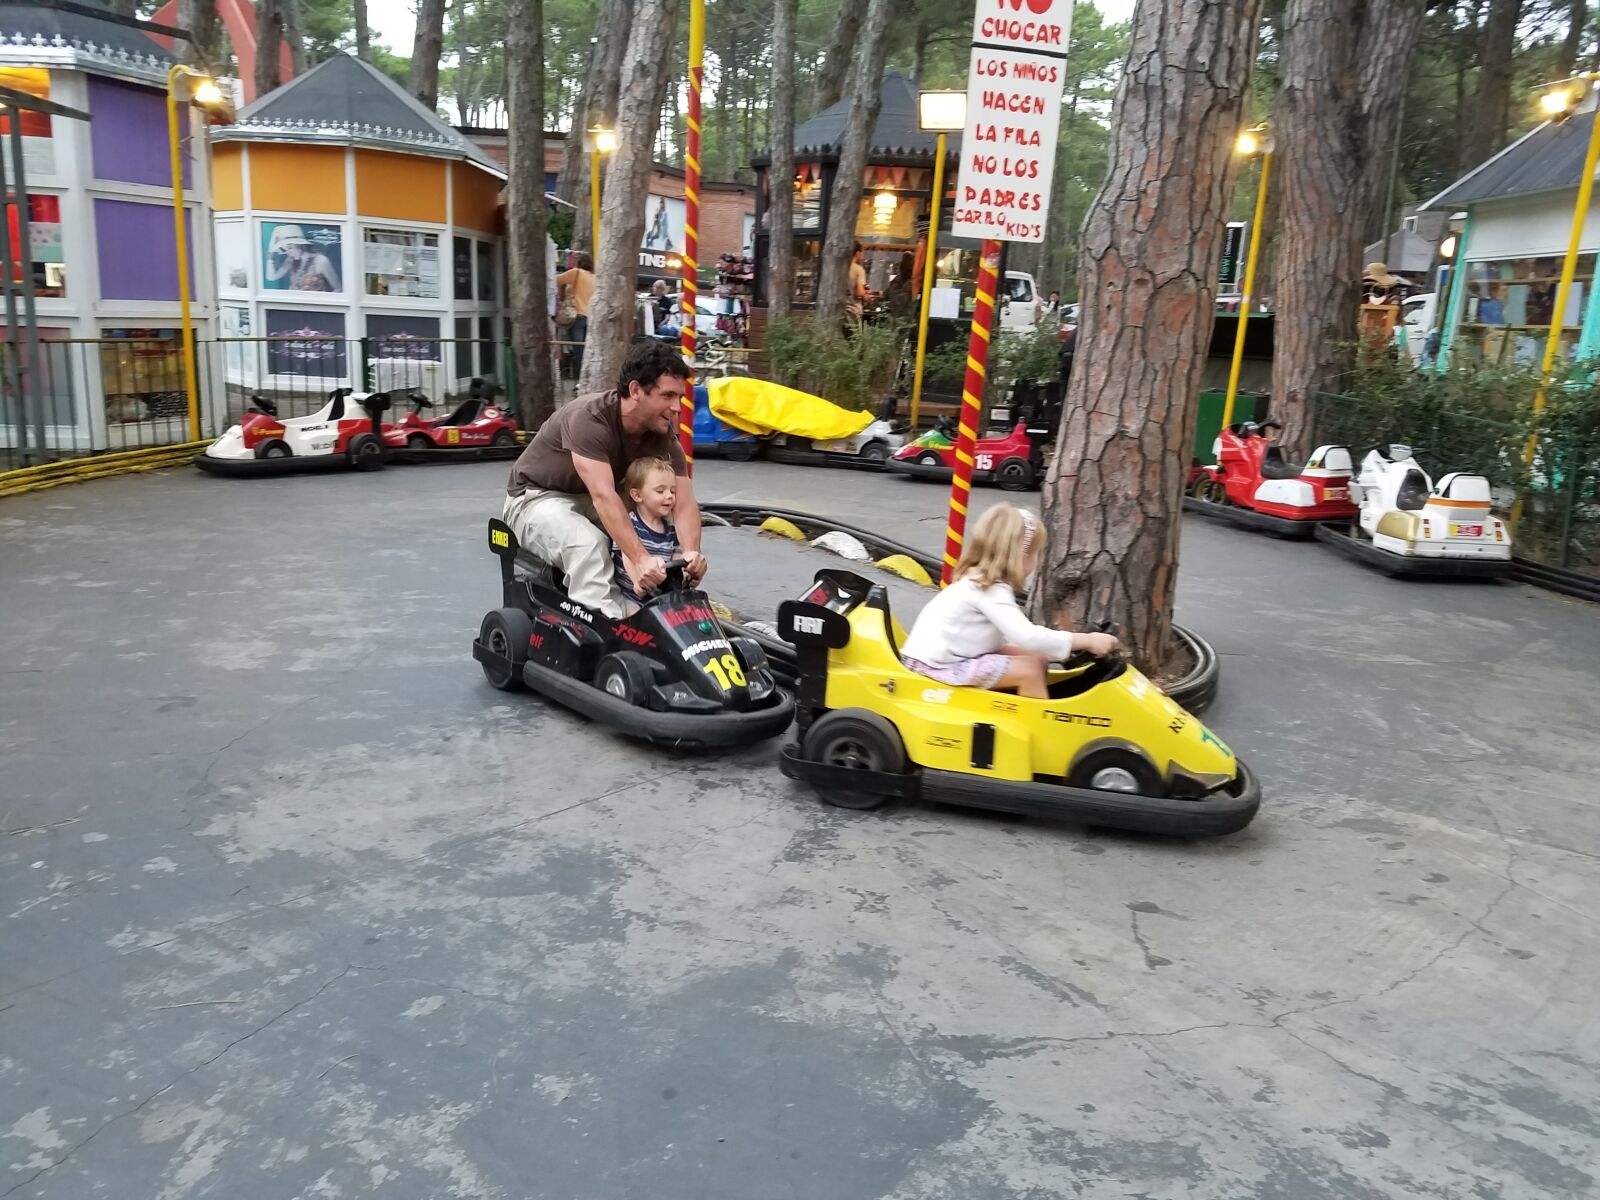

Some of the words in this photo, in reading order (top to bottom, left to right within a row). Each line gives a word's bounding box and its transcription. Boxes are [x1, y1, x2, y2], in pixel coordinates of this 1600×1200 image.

[982, 17, 1061, 45] CHOCAR
[977, 58, 1007, 77] LOS
[983, 90, 1045, 114] HACEN
[976, 123, 996, 142] LA
[1004, 127, 1040, 147] FILA
[973, 154, 997, 174] NO
[1003, 157, 1038, 178] LOS
[965, 186, 1041, 211] PADRES
[1006, 222, 1041, 238] KID'S
[975, 454, 993, 470] 15
[703, 654, 747, 691] 18
[921, 688, 954, 705] elf
[1043, 709, 1112, 729] namco
